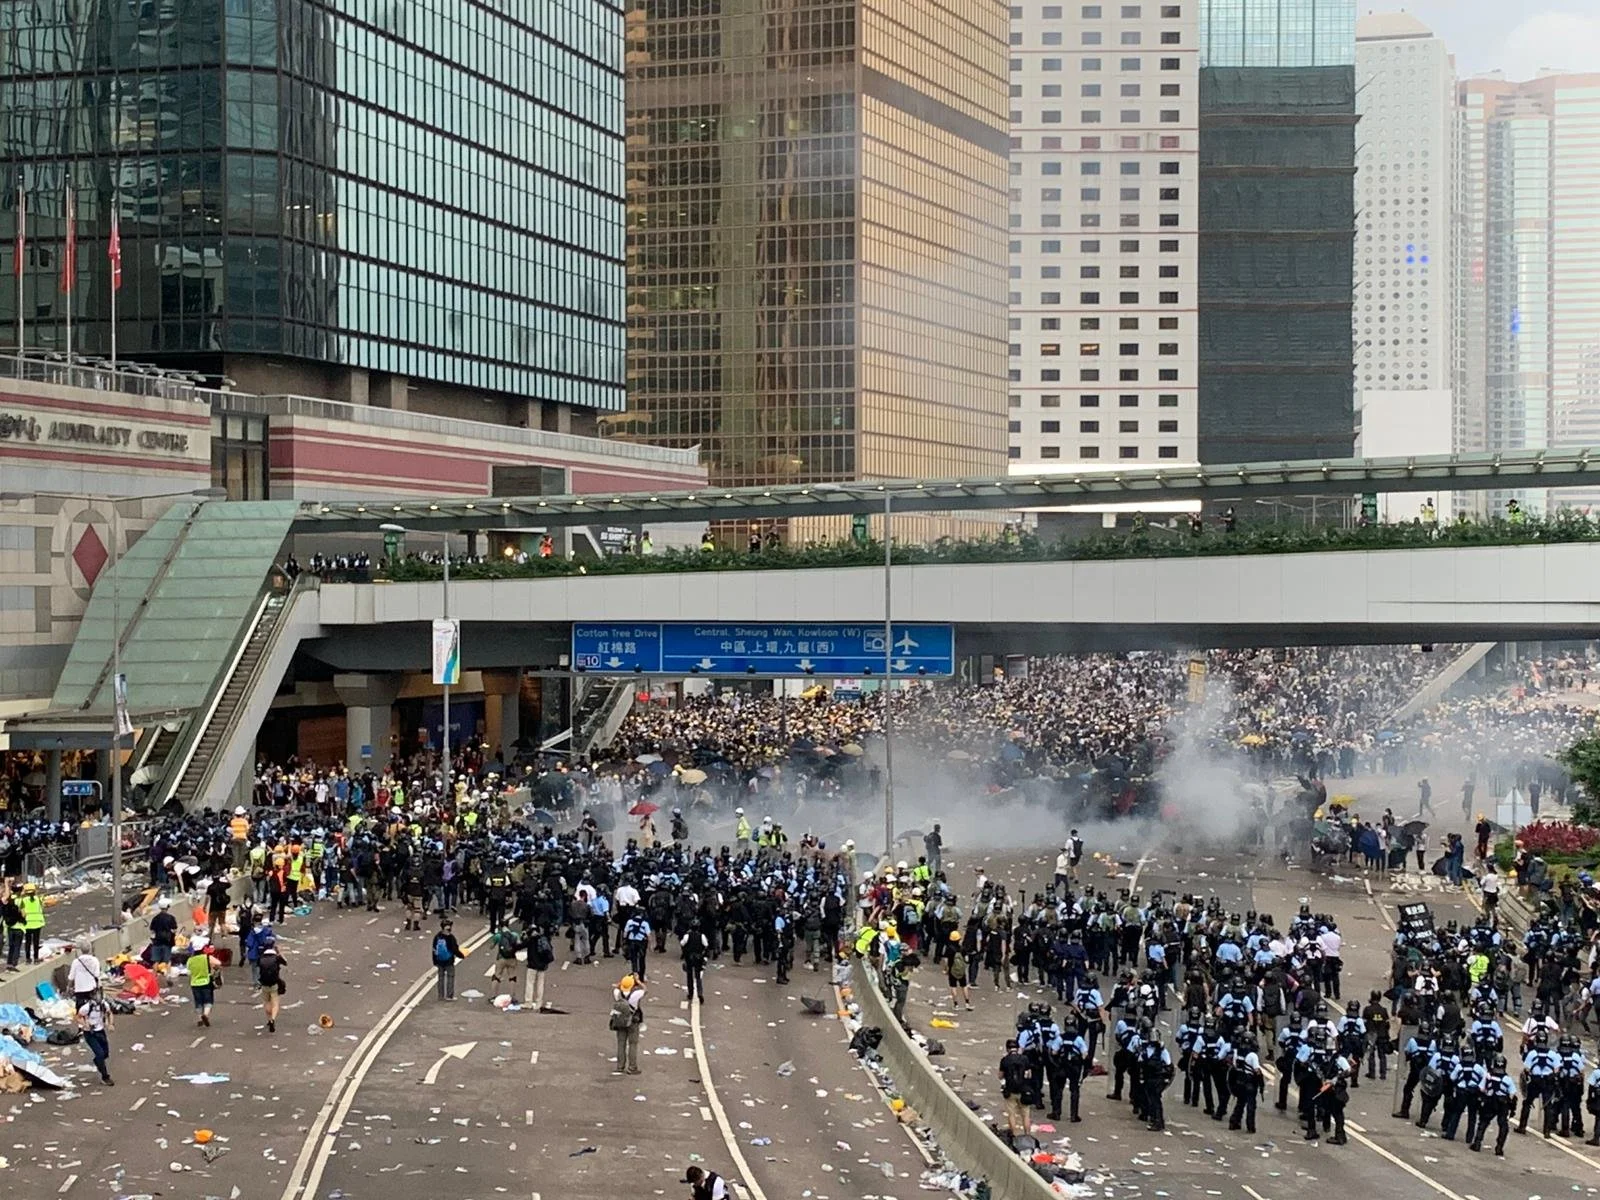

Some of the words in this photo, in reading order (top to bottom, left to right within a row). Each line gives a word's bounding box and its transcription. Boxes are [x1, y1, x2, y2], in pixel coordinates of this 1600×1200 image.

[576, 628, 609, 638] Cotton
[611, 628, 631, 638] Tree
[634, 628, 658, 638] Drive
[735, 627, 768, 638] Sheung
[798, 627, 839, 638] Kowloon
[842, 627, 861, 639] (W)
[597, 641, 636, 654] 紅棉路
[586, 655, 599, 666] 10
